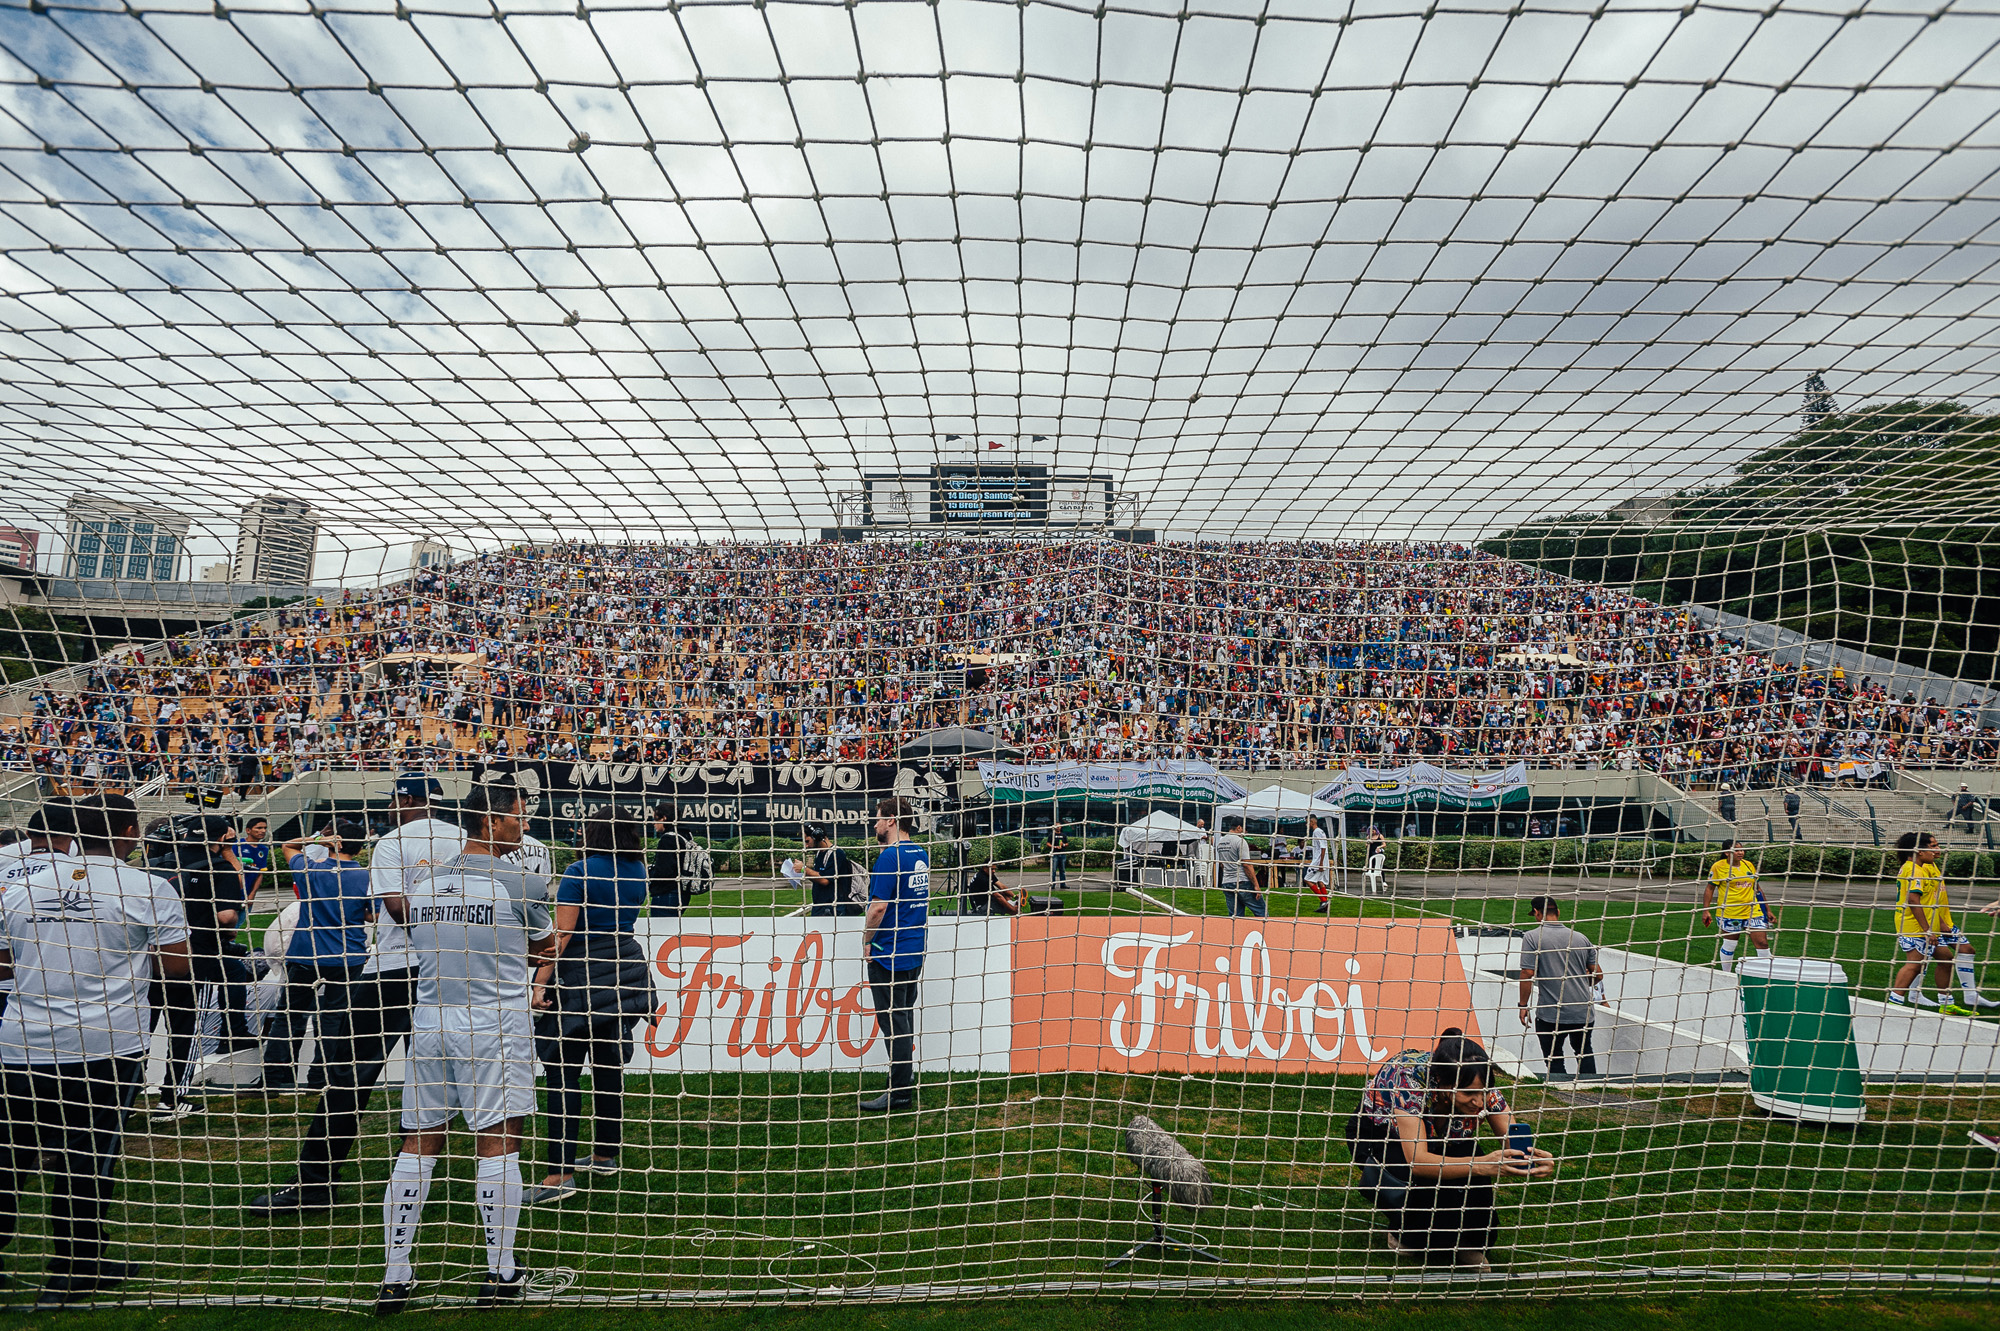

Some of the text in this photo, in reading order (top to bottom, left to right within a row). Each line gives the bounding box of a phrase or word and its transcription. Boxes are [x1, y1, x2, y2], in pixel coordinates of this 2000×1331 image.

[947, 491, 1013, 500] 14 Diego Santos
[568, 760, 861, 791] MUVUCA 1010
[1003, 770, 1040, 788] SPORTS
[1142, 786, 1161, 795] APOIO
[561, 802, 655, 820] GRAEZA
[682, 803, 738, 821] AMOR
[765, 802, 870, 825] HUMILDADE
[506, 845, 547, 865] FRAZIER
[7, 864, 48, 879] STAFF
[421, 904, 494, 926] ARBITRAGEM
[644, 930, 880, 1058] Fribo
[1101, 930, 1389, 1062] Friboi
